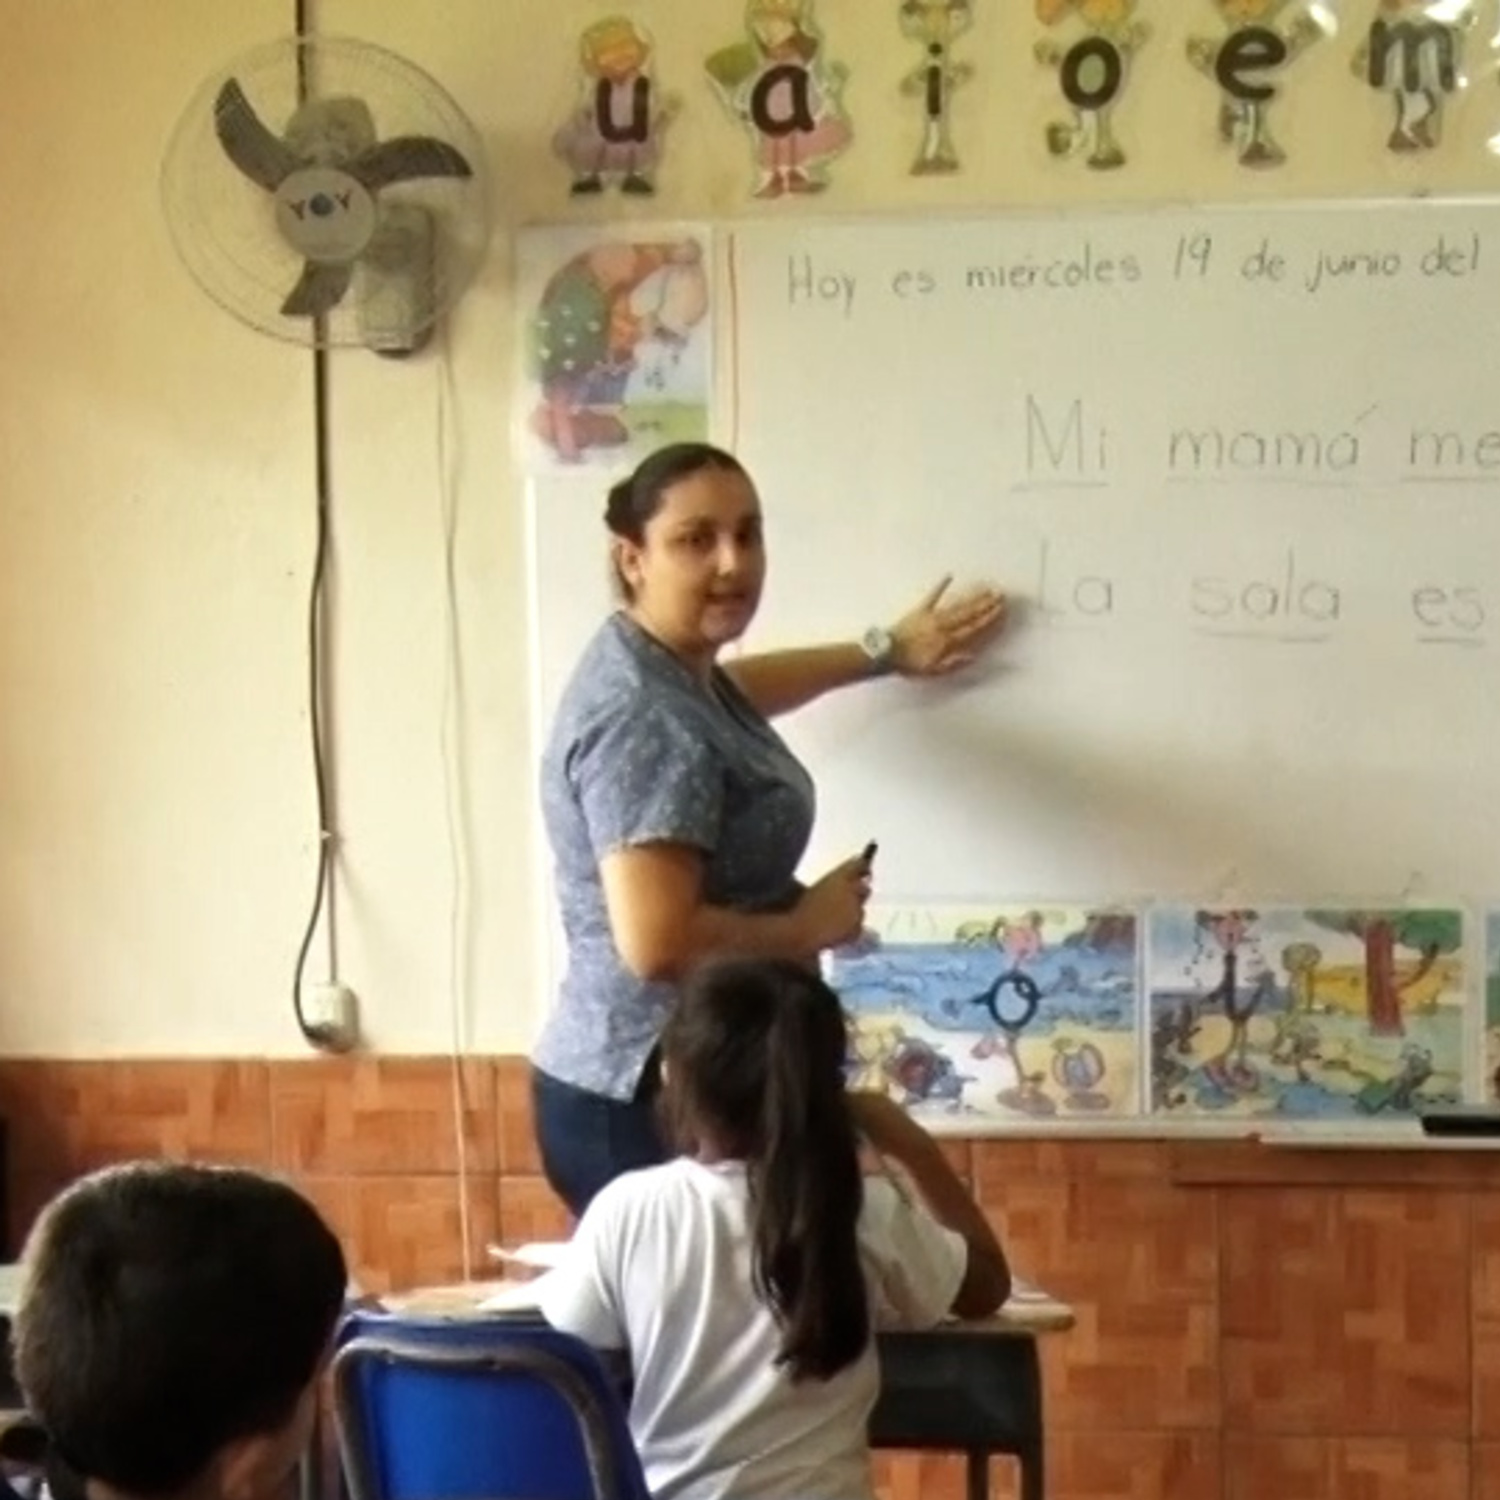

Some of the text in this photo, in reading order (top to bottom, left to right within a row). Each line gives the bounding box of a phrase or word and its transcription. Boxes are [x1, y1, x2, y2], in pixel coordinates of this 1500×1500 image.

[599, 75, 649, 143] u
[750, 64, 815, 136] a
[926, 42, 943, 118] i
[1059, 36, 1122, 109] o
[1215, 26, 1287, 100] e
[1369, 19, 1455, 93] m
[787, 253, 857, 320] Hoy
[892, 268, 936, 297] es
[1173, 232, 1211, 280] 19
[1240, 238, 1286, 281] de
[1305, 247, 1401, 293] junio
[1420, 233, 1479, 278] del
[1022, 393, 1109, 472] Mi
[1166, 404, 1379, 471] mamá
[1190, 544, 1342, 620] sala
[1411, 585, 1487, 632] es
